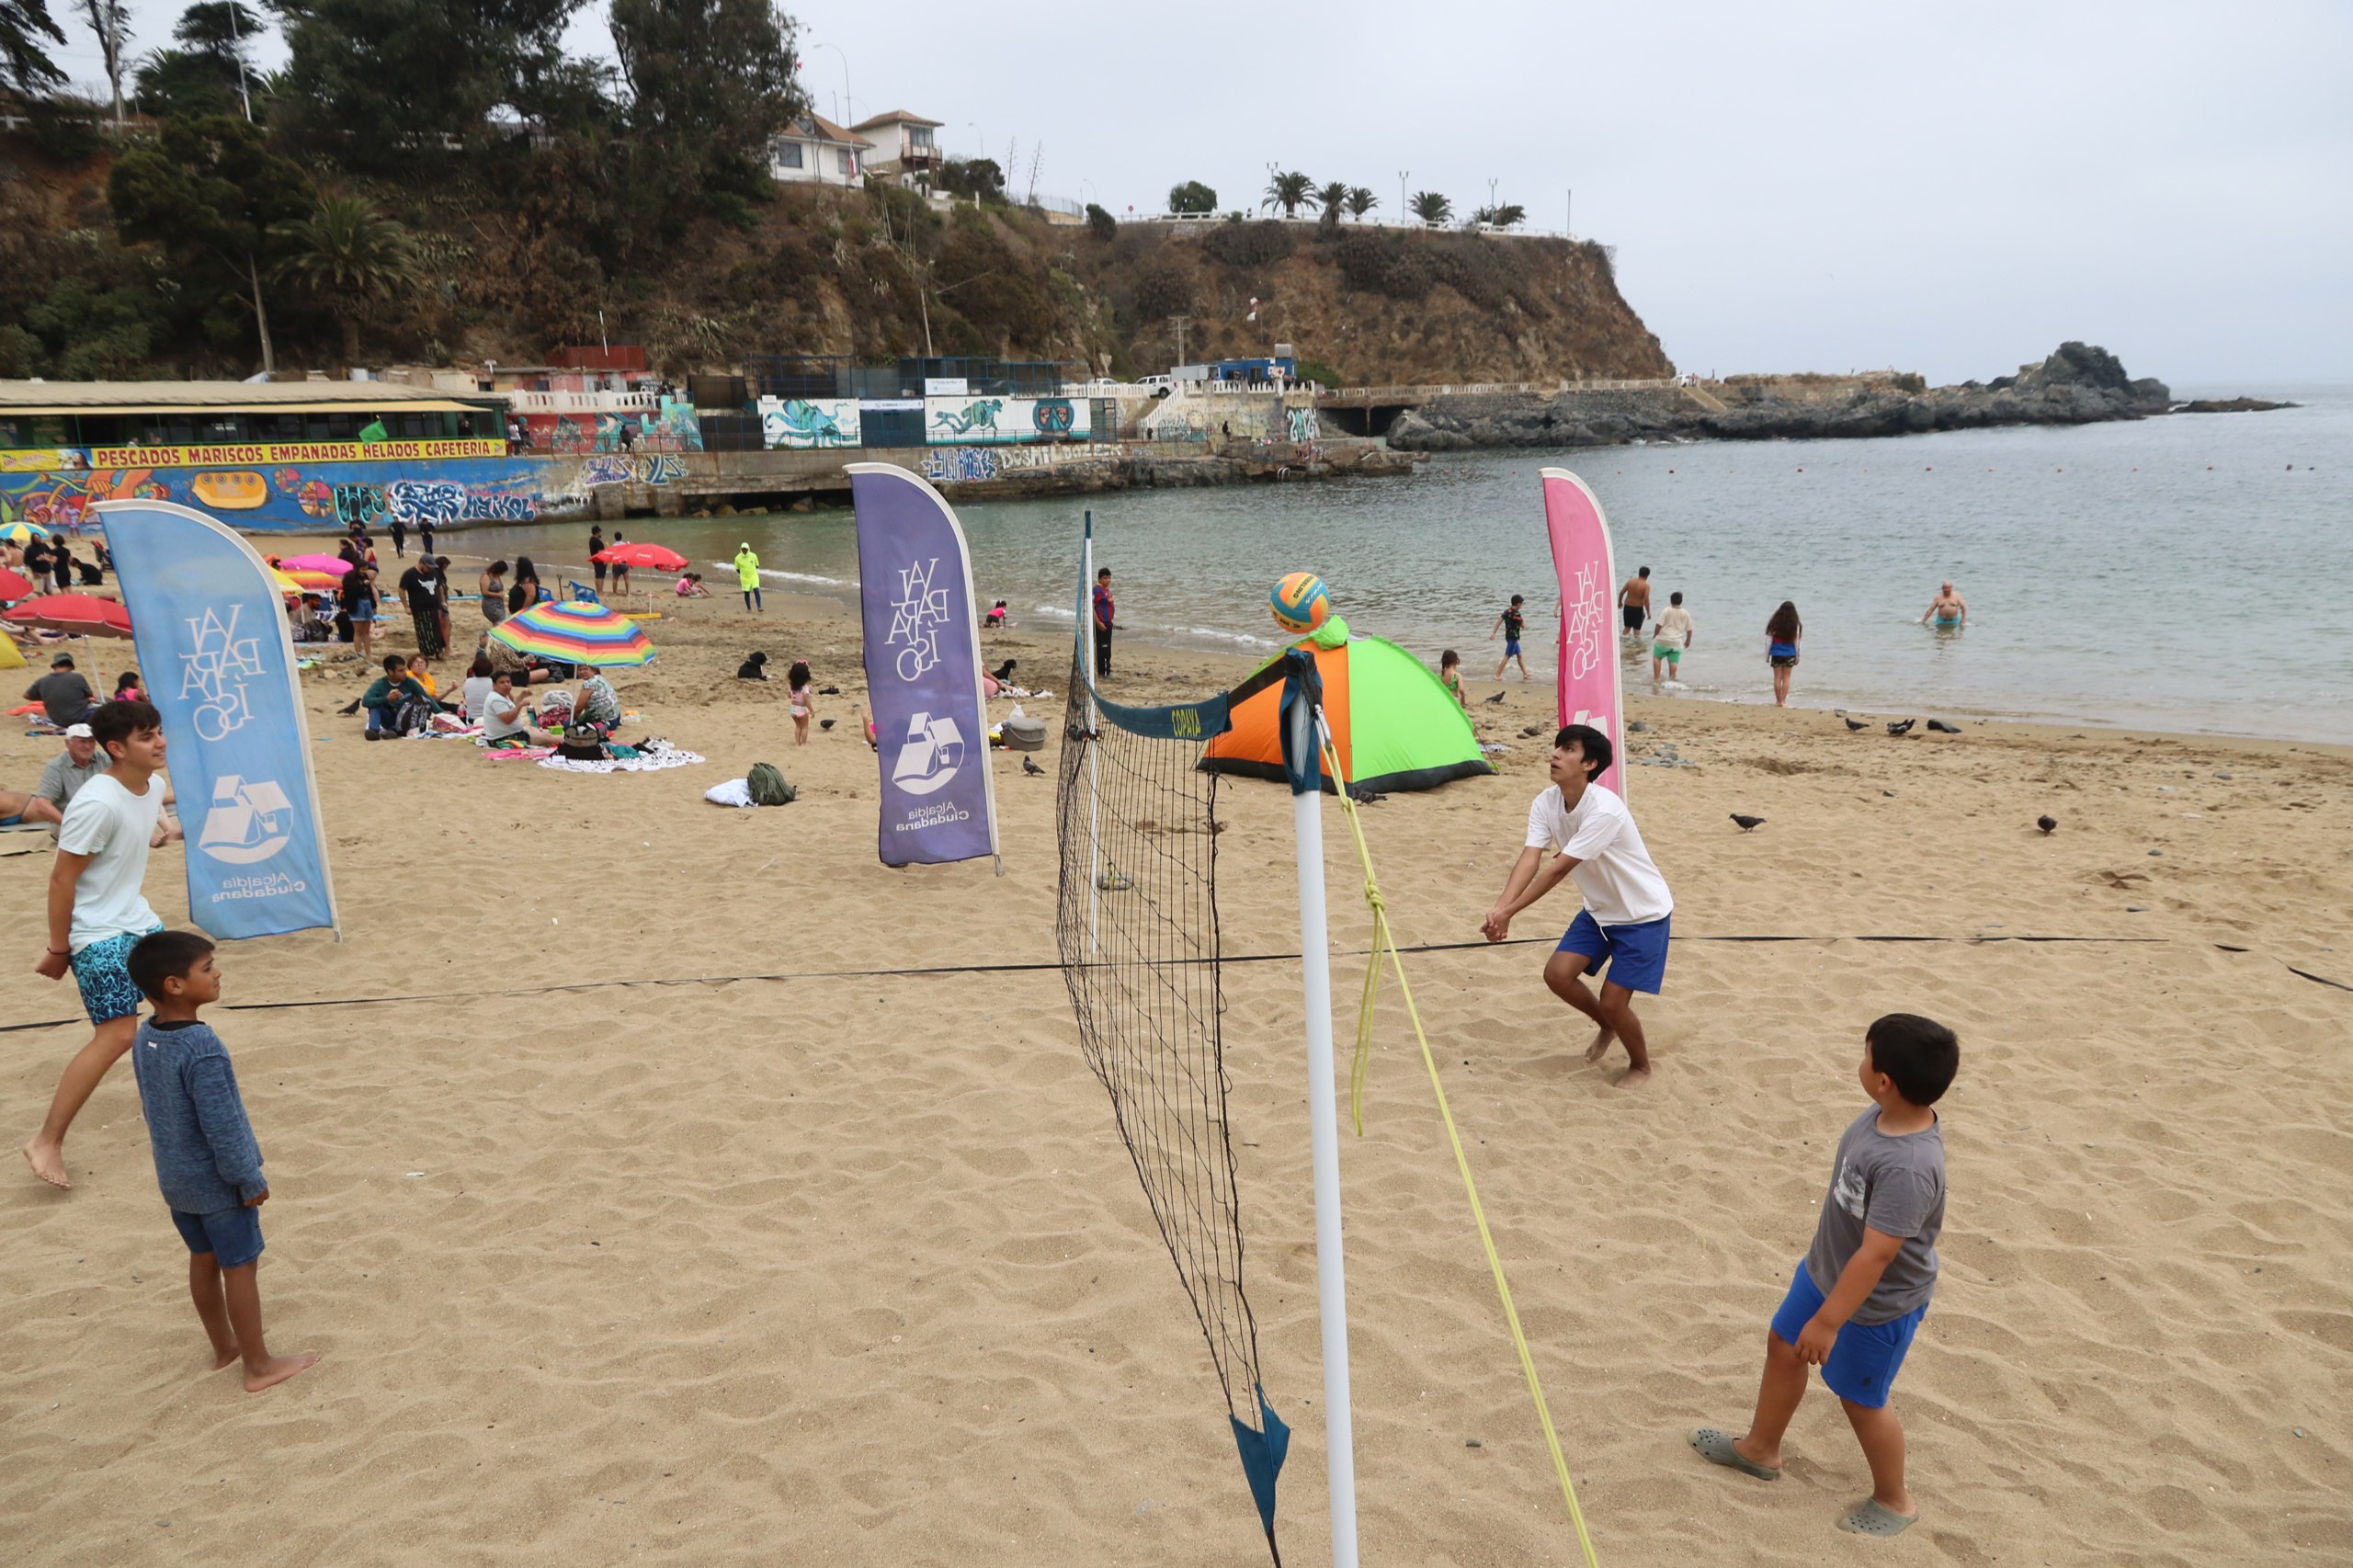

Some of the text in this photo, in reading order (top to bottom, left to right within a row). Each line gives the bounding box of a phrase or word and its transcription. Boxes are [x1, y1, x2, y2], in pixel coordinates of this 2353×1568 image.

[97, 449, 181, 466] PESCADOS
[188, 447, 264, 463] MARISCOS
[271, 445, 357, 460] EMPANADAS
[363, 441, 420, 458] HELADOS
[426, 441, 491, 456] CAFETERIA
[1171, 707, 1201, 738] COPAYA
